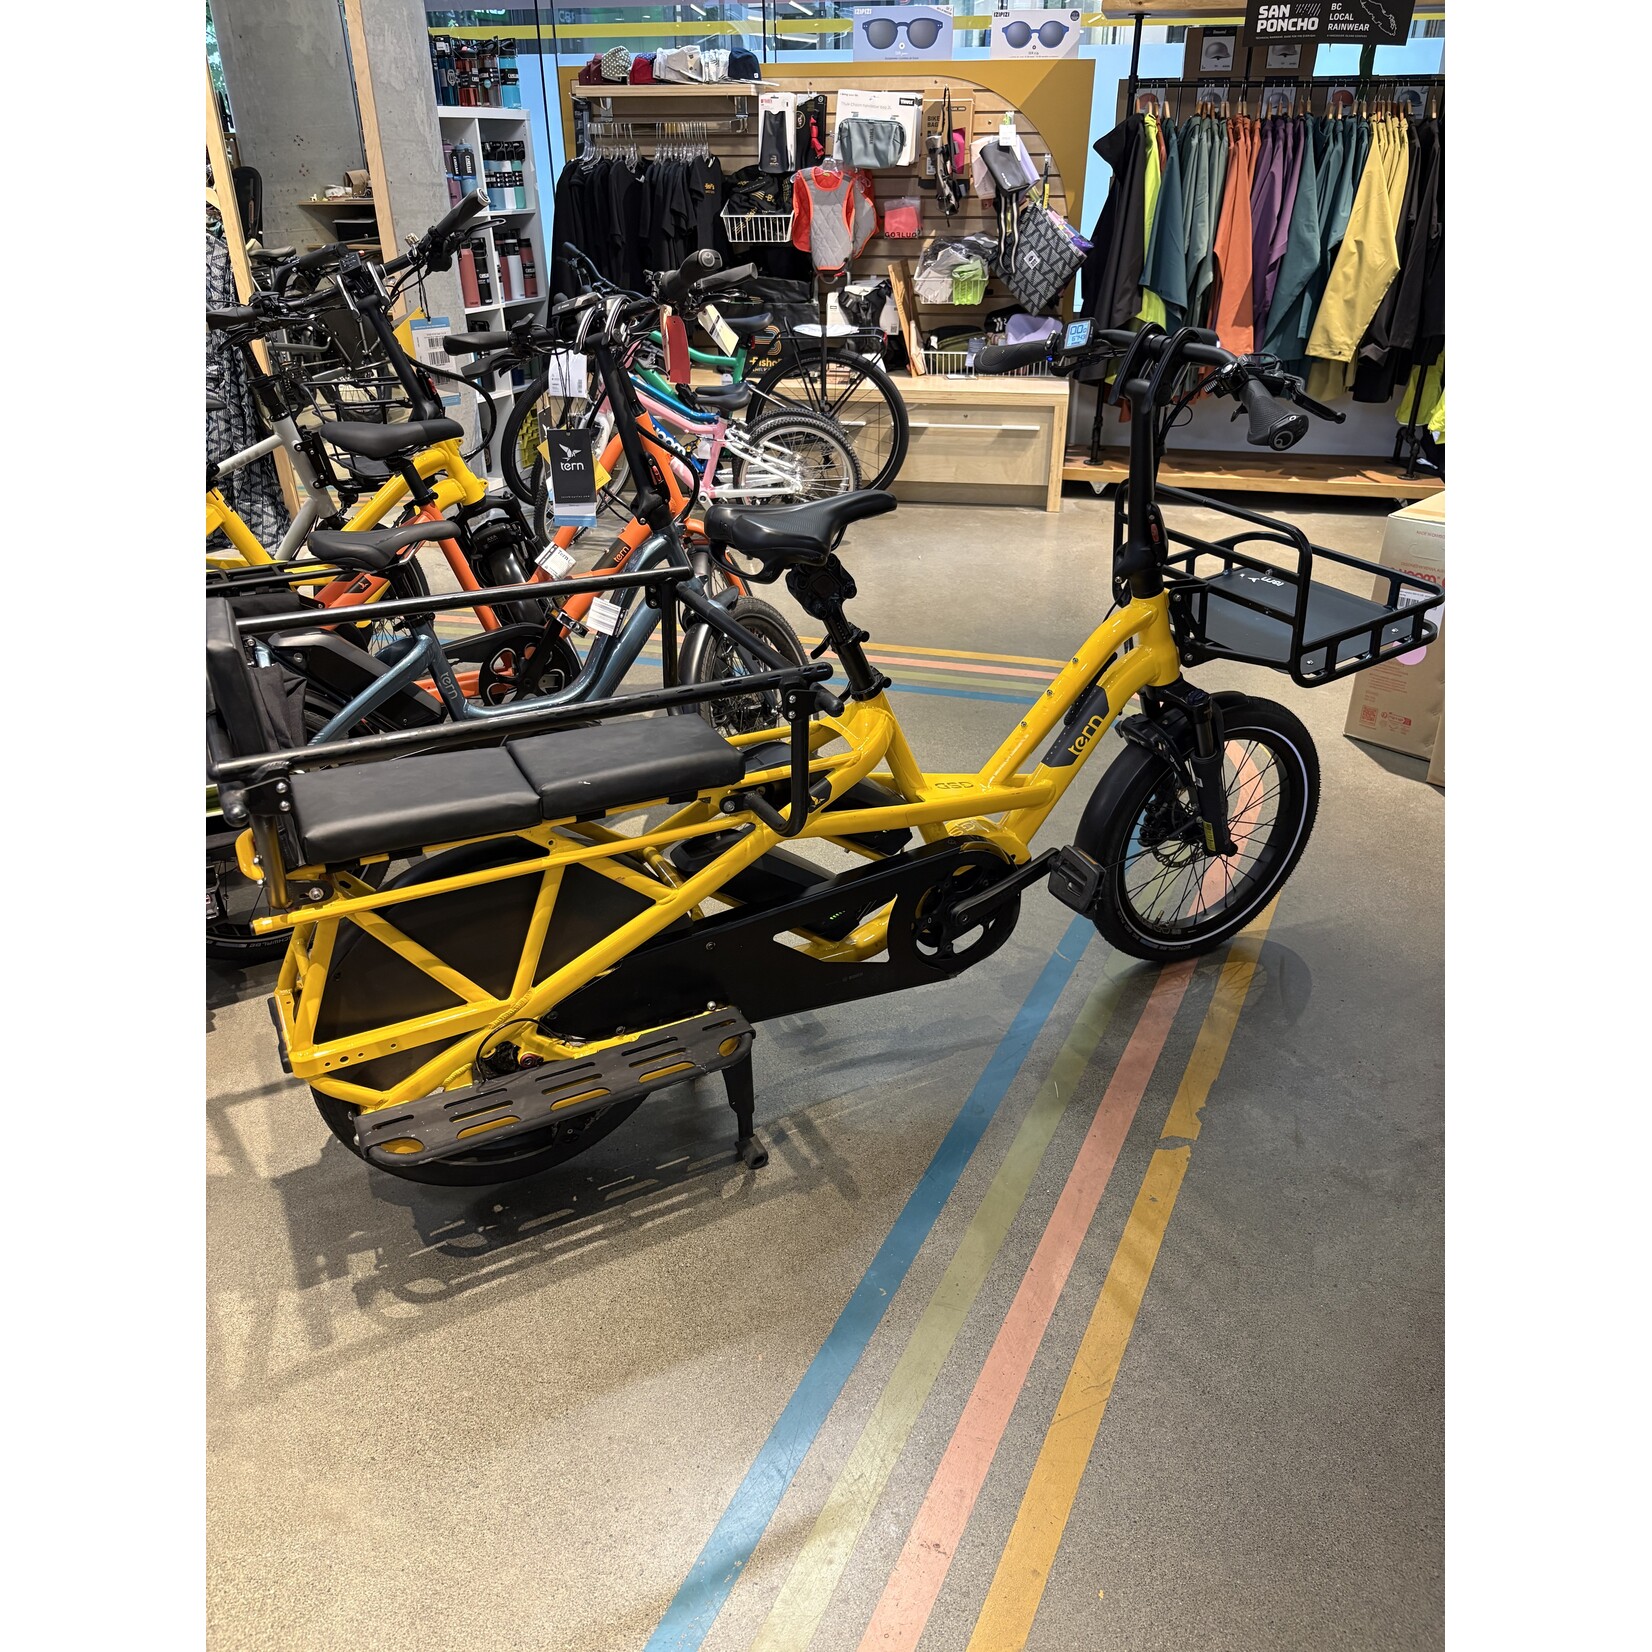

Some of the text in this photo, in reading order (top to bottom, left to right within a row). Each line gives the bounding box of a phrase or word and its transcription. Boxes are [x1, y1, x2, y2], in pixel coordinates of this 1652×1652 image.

[1258, 4, 1290, 19] SAN
[1331, 3, 1342, 11] BC
[1329, 13, 1354, 21] LOCAL
[1256, 17, 1319, 33] PONCHO
[1327, 23, 1370, 32] RAINWEAR
[560, 462, 585, 471] tern
[613, 546, 630, 563] tern
[440, 672, 458, 700] tern
[1067, 715, 1104, 755] tern
